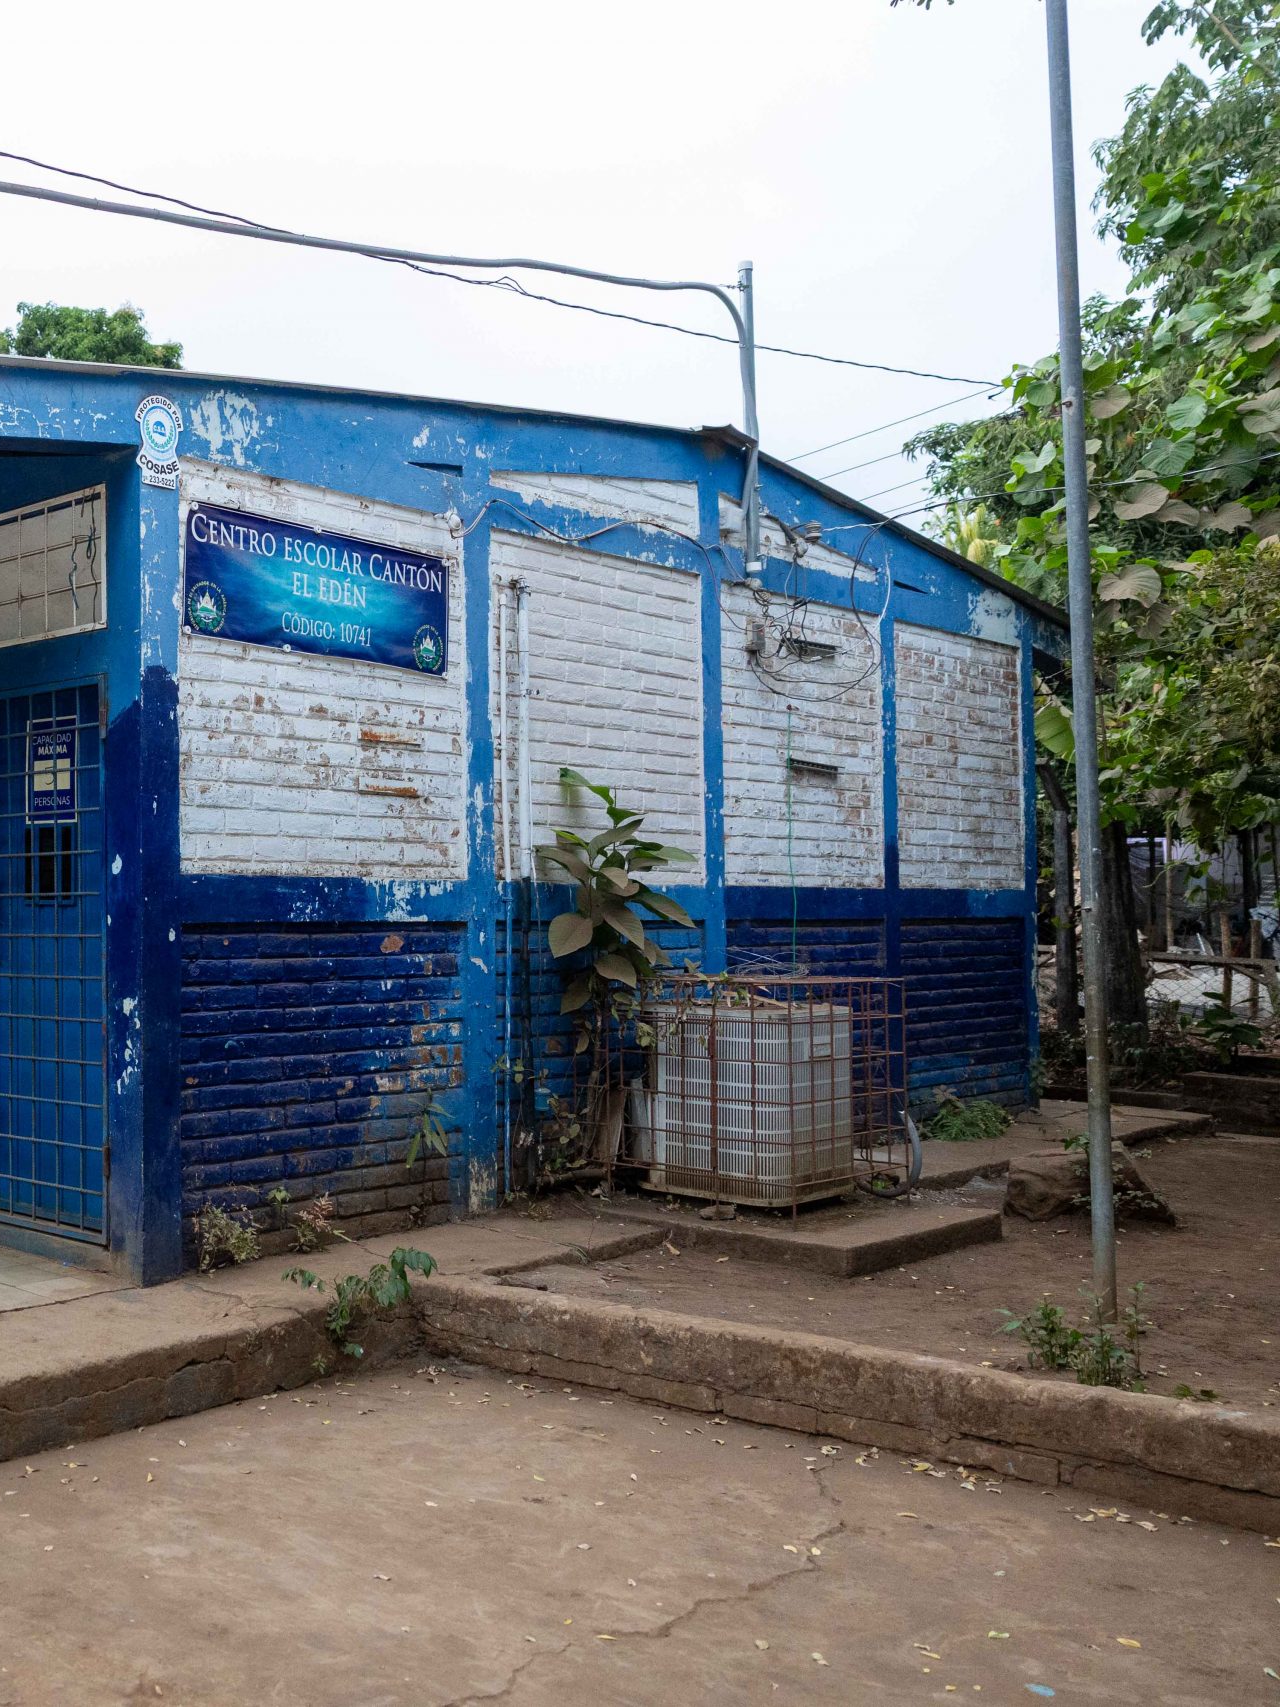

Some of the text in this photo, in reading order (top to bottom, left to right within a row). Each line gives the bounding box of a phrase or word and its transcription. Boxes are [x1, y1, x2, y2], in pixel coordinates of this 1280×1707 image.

[137, 397, 182, 429] PROTEGIDO POR
[140, 454, 180, 475] COSASE
[149, 475, 175, 488] 233-5222
[191, 513, 443, 593] CENTRO ESCOLAR CANTÓN
[292, 572, 367, 608] EL EDÉN
[282, 612, 371, 647] CÓDIGO: 10741
[33, 733, 72, 745] CAPACDAD
[38, 744, 68, 756] MÁXMA
